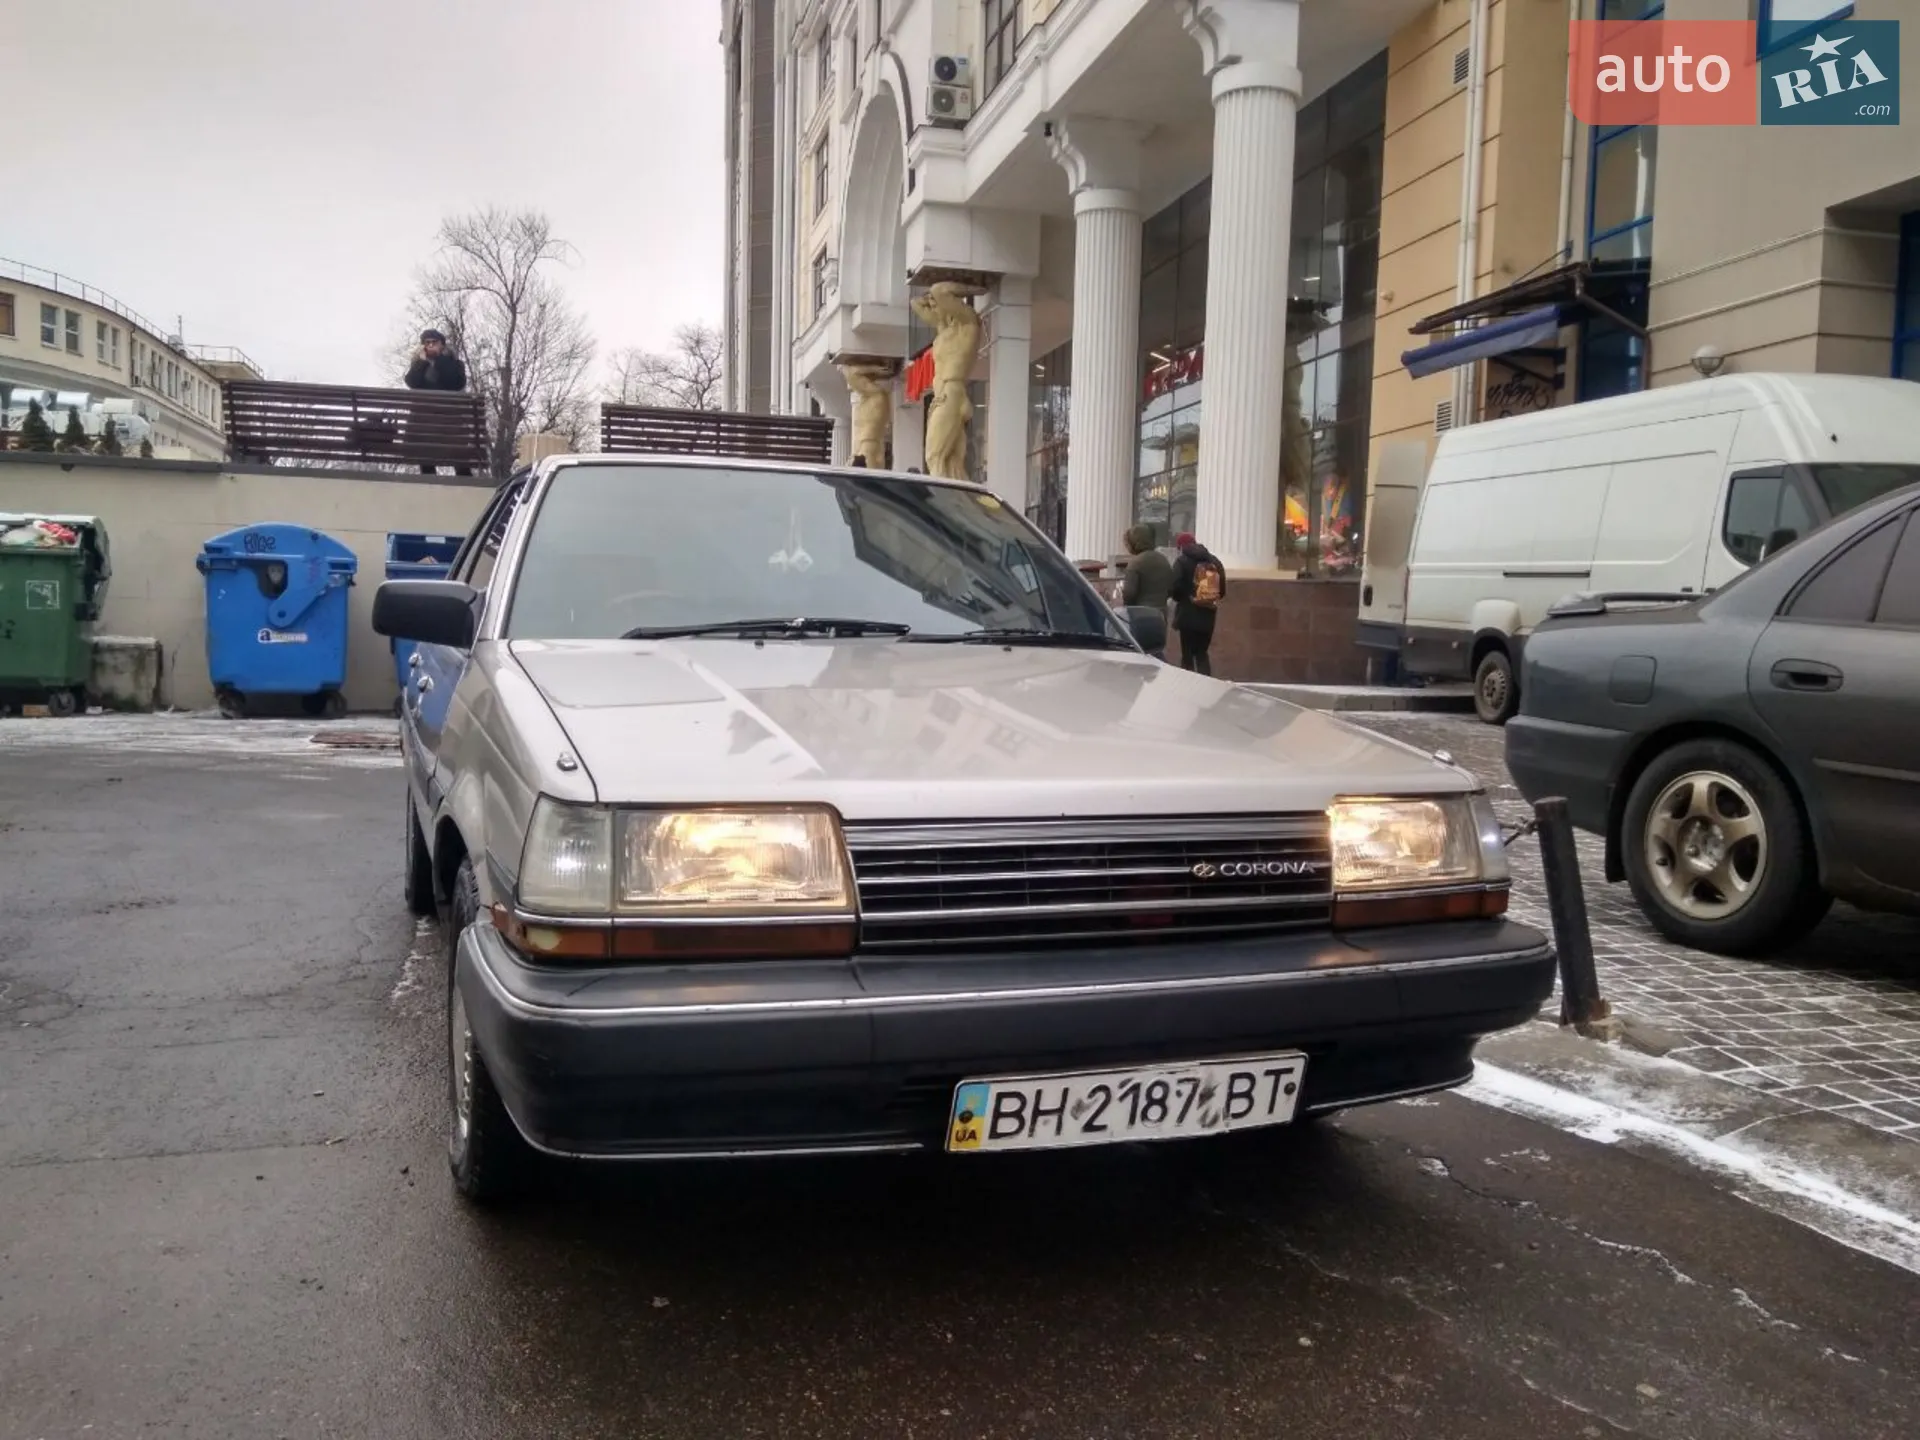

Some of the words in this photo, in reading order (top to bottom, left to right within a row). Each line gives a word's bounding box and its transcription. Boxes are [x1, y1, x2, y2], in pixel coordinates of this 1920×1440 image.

[1220, 861, 1315, 876] CORONA
[988, 1087, 1068, 1140] BH
[1081, 1077, 1200, 1133] 2187
[1224, 1067, 1294, 1121] BT
[955, 1128, 977, 1142] UA
